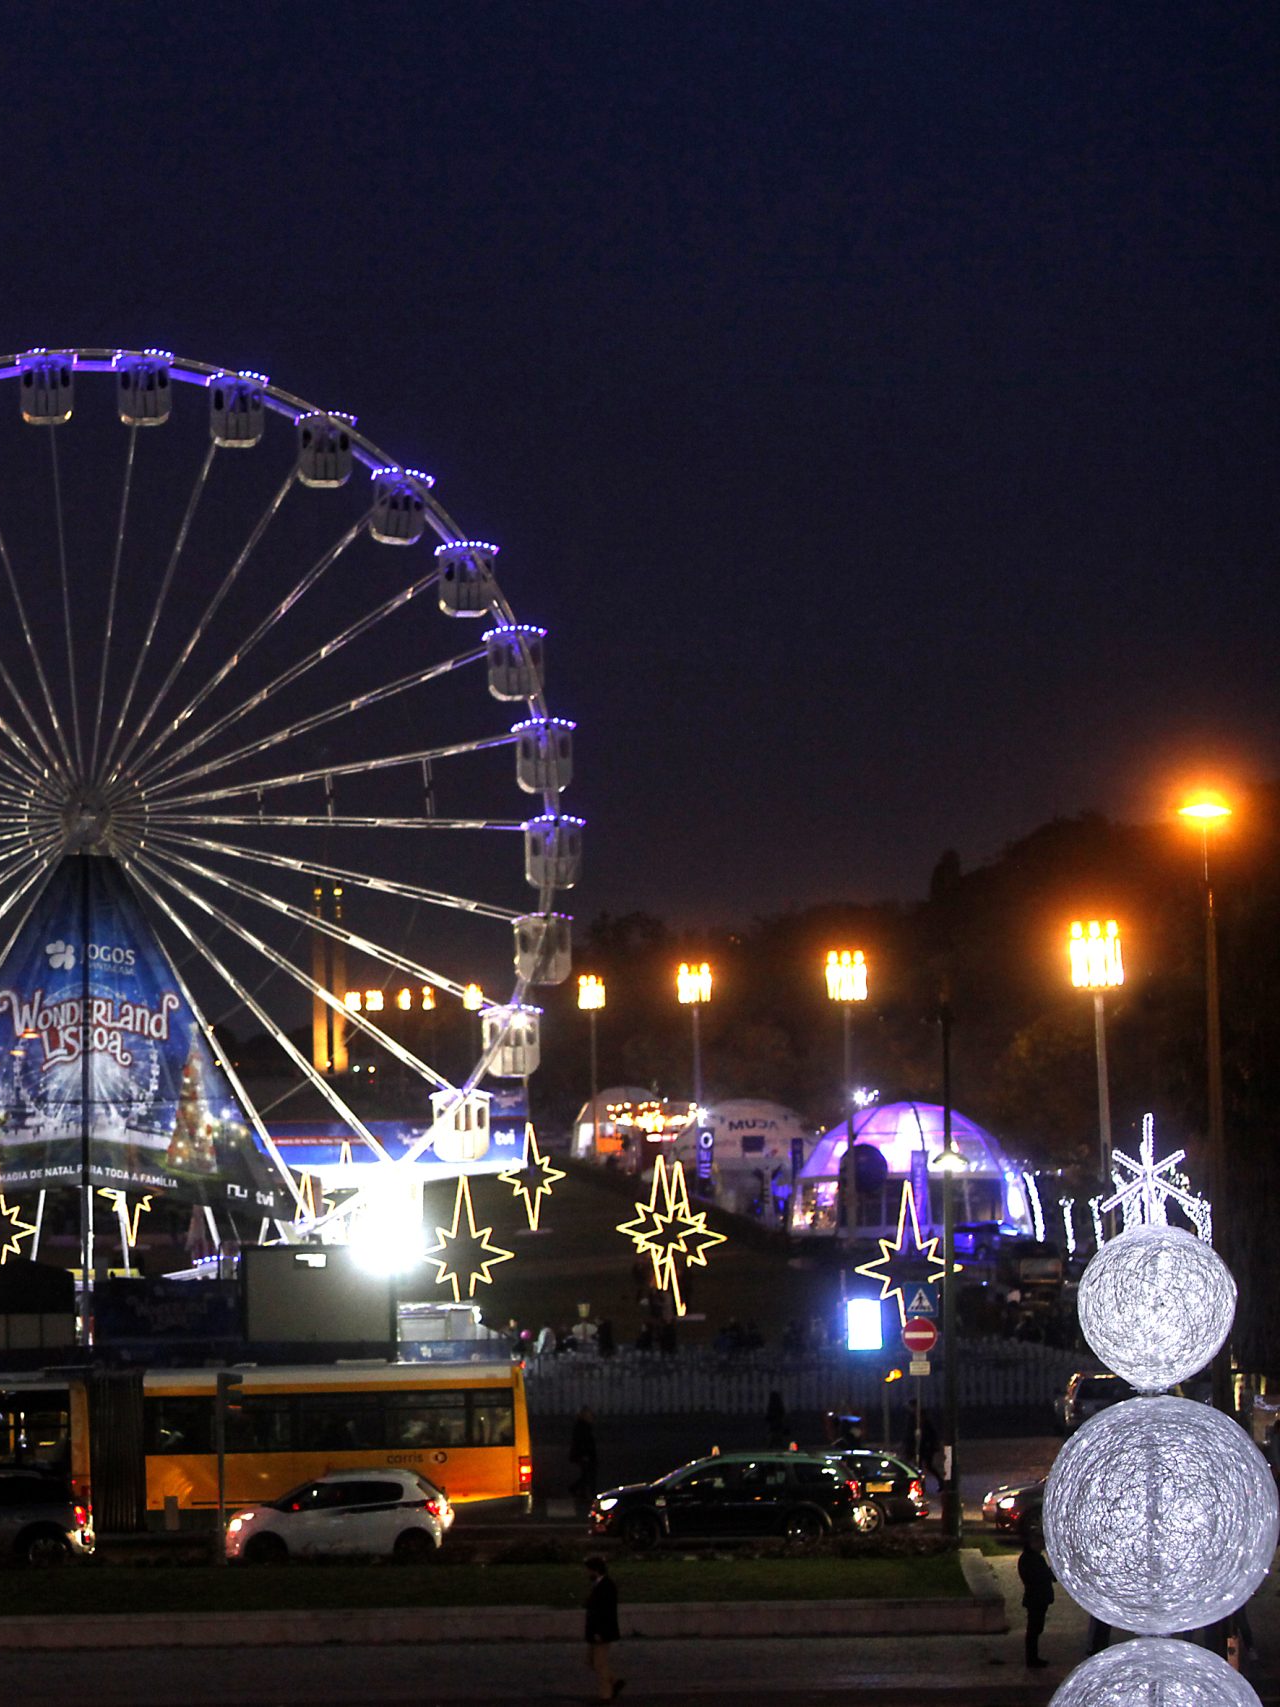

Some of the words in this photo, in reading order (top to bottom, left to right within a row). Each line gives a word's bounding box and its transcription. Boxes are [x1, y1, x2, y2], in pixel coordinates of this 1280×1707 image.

[29, 1169, 43, 1179] DE
[44, 1165, 75, 1177] NATAL
[76, 1163, 103, 1176] PRA
[104, 1167, 130, 1180] TODA
[131, 1172, 139, 1181] A
[140, 1173, 178, 1188] FAMÍLIA
[255, 1190, 274, 1207] tvi
